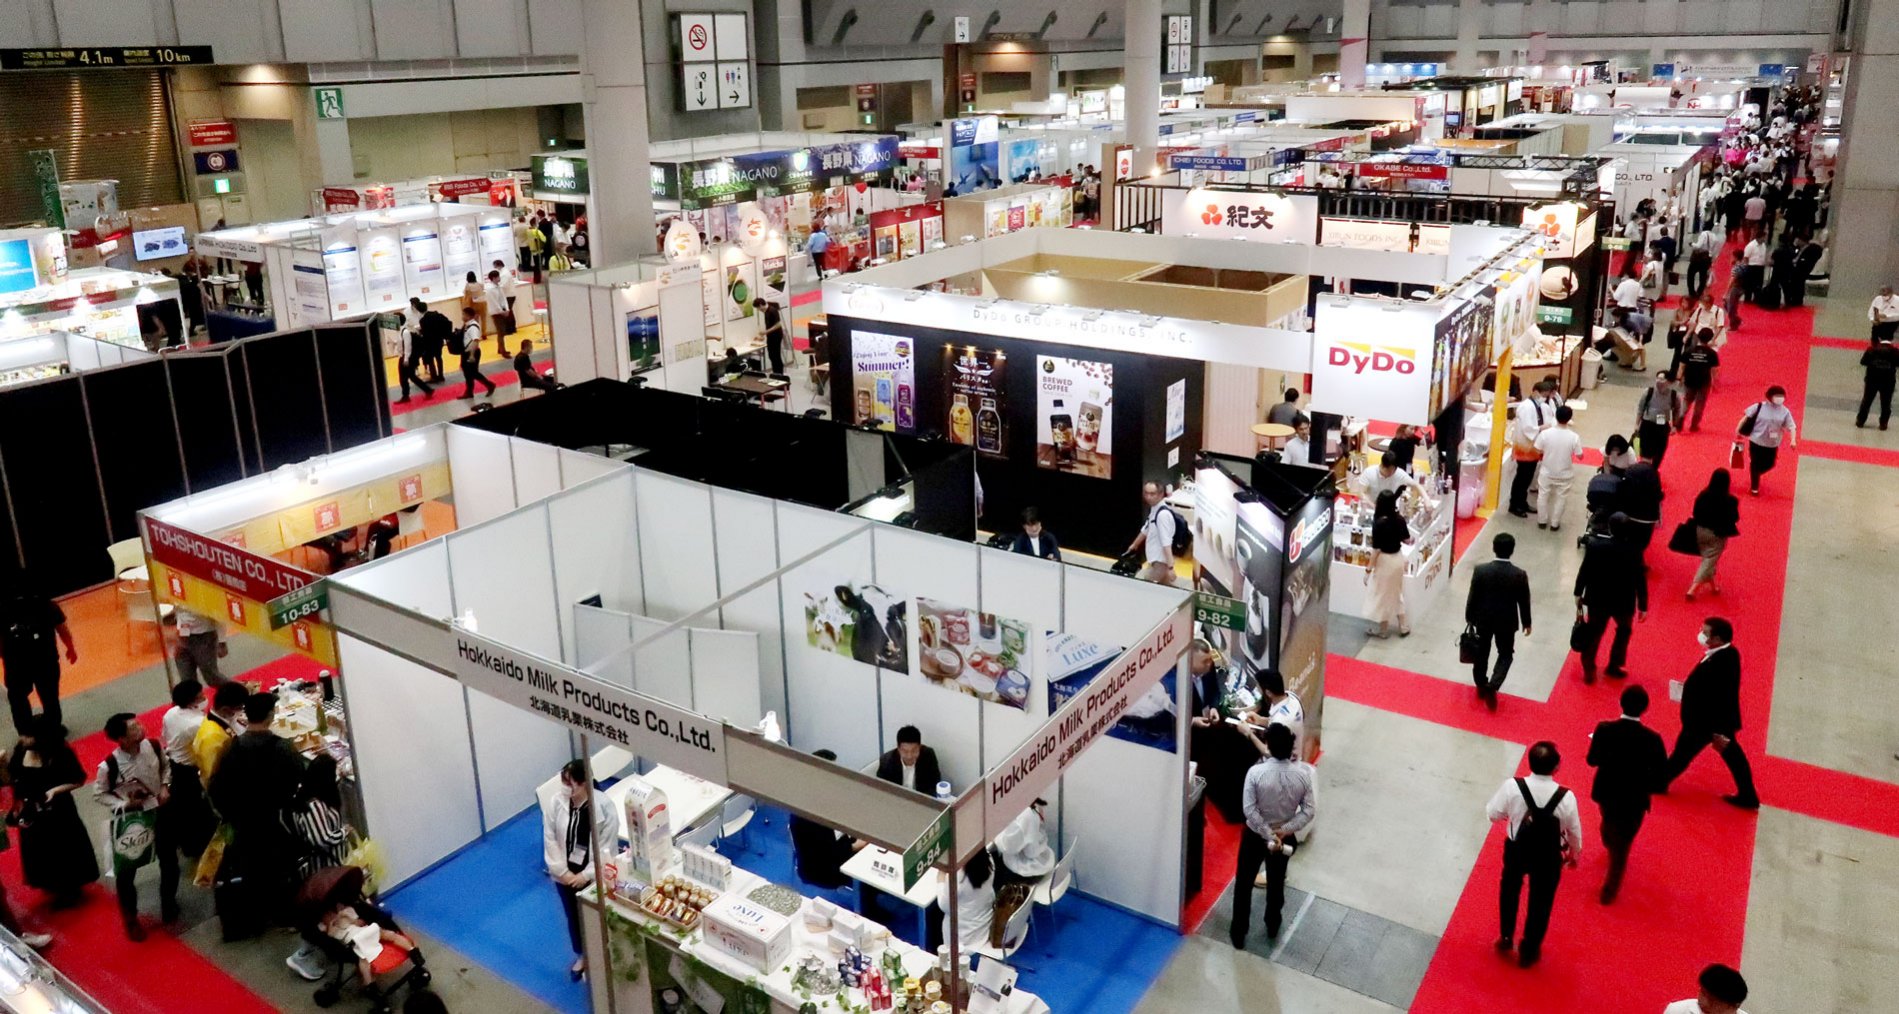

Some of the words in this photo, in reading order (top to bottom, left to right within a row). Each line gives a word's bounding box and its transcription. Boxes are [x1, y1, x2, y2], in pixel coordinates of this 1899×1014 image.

[854, 149, 891, 165] NAGANO
[1192, 157, 1214, 165] FOODS
[731, 166, 778, 184] NAGANO
[1373, 163, 1401, 172] OKABE
[545, 179, 576, 189] NAGANO
[1226, 204, 1274, 230] 紀文
[973, 308, 1007, 322] DyDo
[1014, 313, 1062, 328] GROUP
[857, 358, 910, 373] Summer!
[1329, 346, 1415, 375] DyDo
[1042, 376, 1073, 387] BREWED
[1042, 383, 1069, 393] COFFEE
[150, 523, 243, 573] TOHSHOUTEN
[281, 599, 319, 624] 10-83
[1198, 608, 1230, 627] 9-82
[1062, 643, 1098, 666] Luxe
[457, 638, 524, 683] Hokkaido
[527, 666, 558, 696] Milk
[563, 680, 640, 726] Products
[645, 709, 716, 752] Co.,Ltd.
[530, 695, 629, 746] 北海道乳業株式会社
[993, 735, 1056, 805] Hokkaido
[1059, 708, 1084, 745] Milk
[1086, 662, 1137, 719] Products
[916, 841, 941, 877] 9-84
